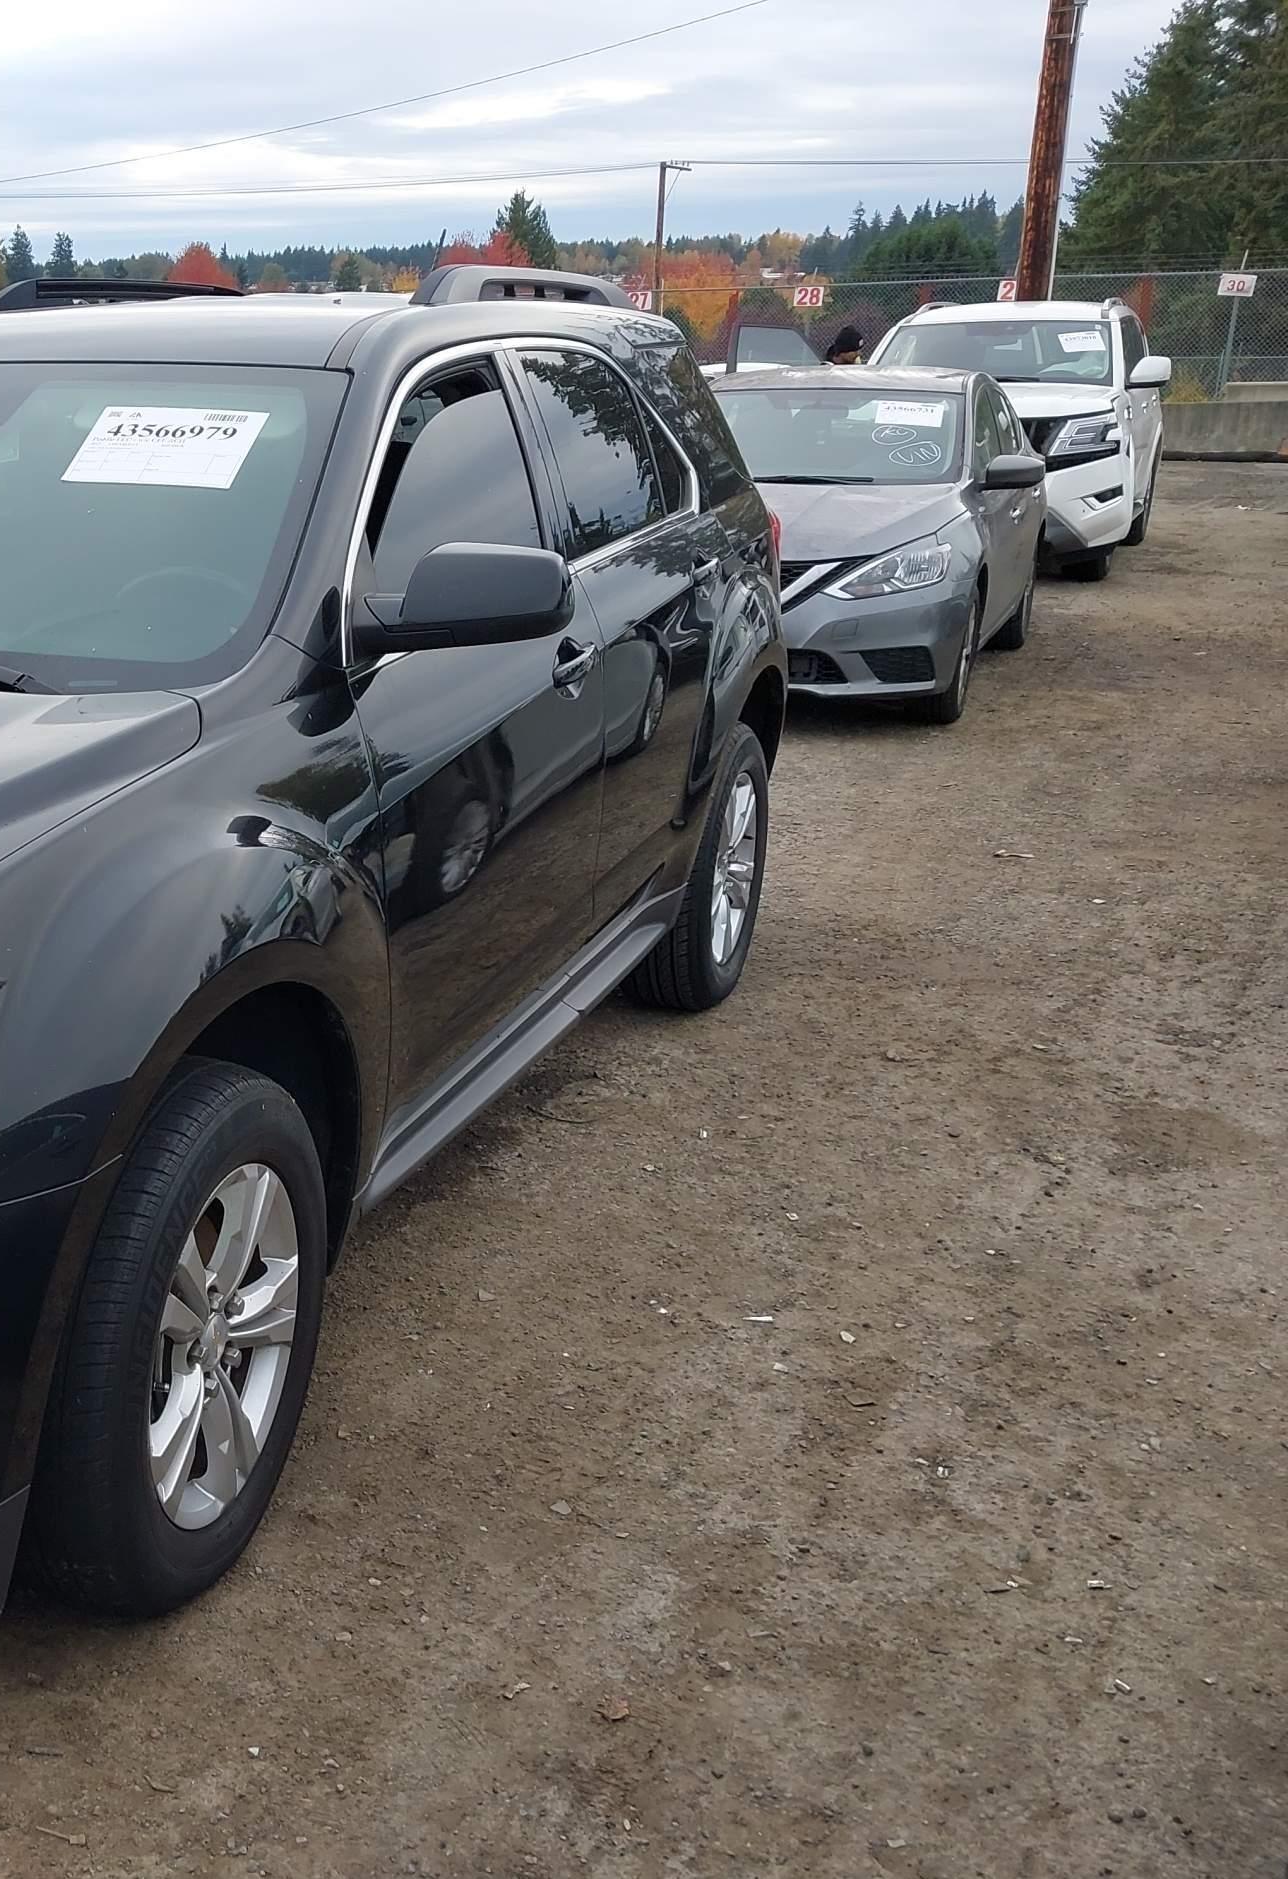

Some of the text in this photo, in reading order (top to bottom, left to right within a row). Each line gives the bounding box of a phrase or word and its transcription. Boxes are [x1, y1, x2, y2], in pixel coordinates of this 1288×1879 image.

[1000, 281, 1015, 300] 2
[1227, 279, 1246, 292] 30
[630, 292, 649, 310] 27
[796, 287, 821, 306] 28
[107, 423, 238, 441] 43566979
